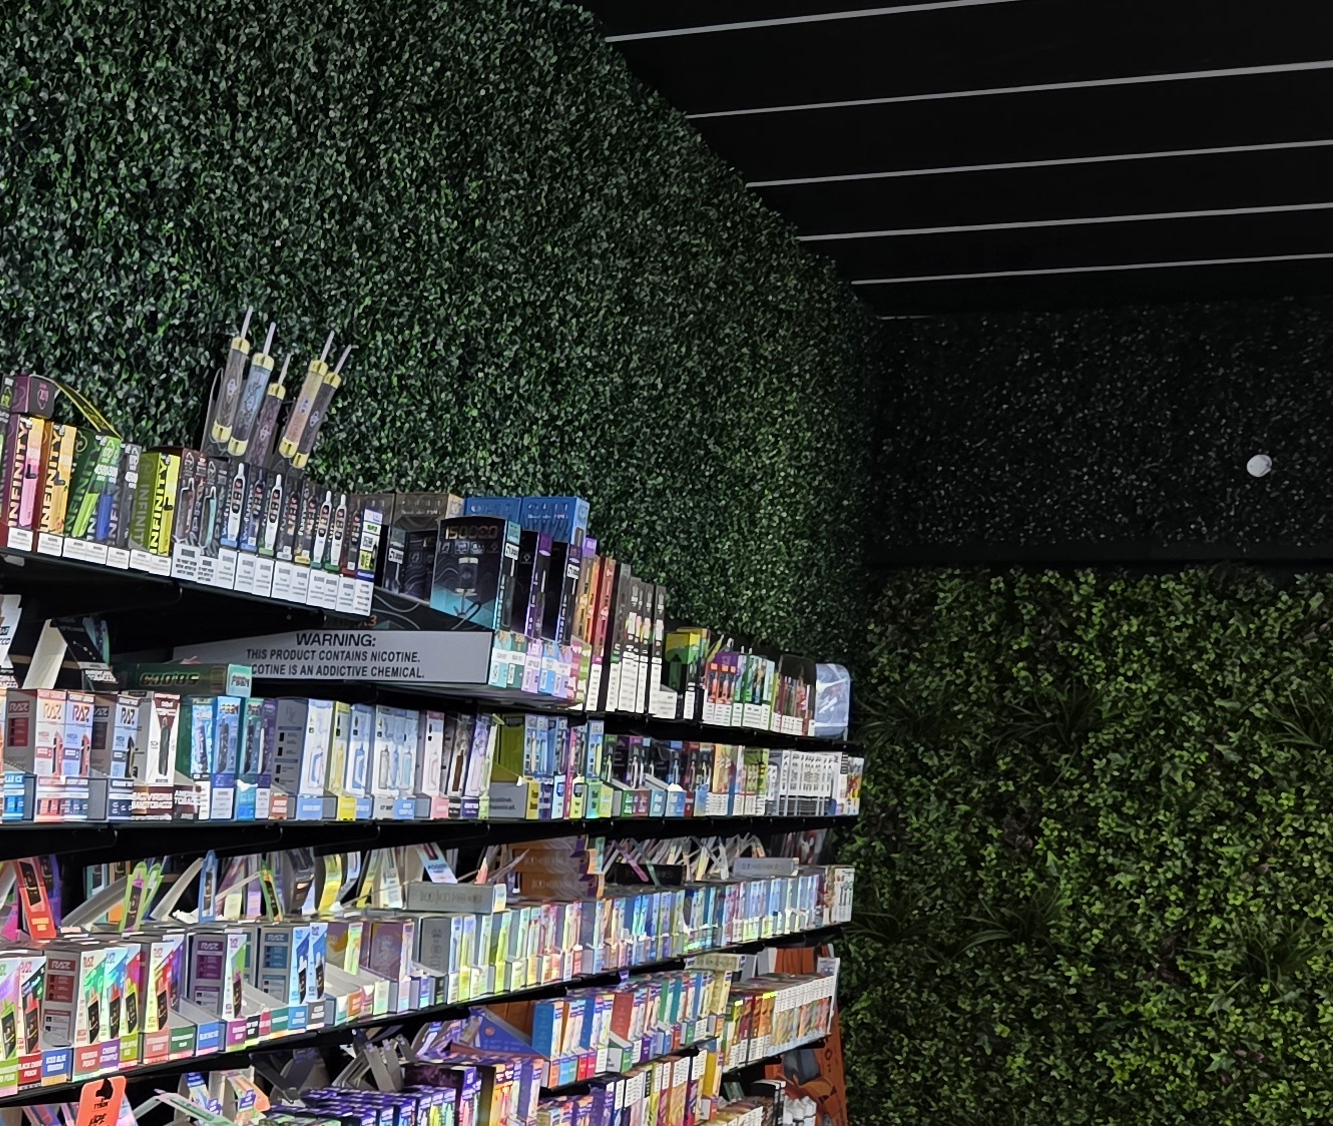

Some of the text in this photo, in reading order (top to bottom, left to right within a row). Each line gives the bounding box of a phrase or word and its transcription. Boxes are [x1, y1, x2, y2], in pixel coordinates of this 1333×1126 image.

[8, 422, 28, 527] INFINITY
[297, 633, 376, 647] WARNING:
[247, 649, 420, 662] THIS PRODUCT CONTAINS NICOTINE.
[252, 665, 425, 678] COTINE IS AN ADDICTIVE CHEMICAL.
